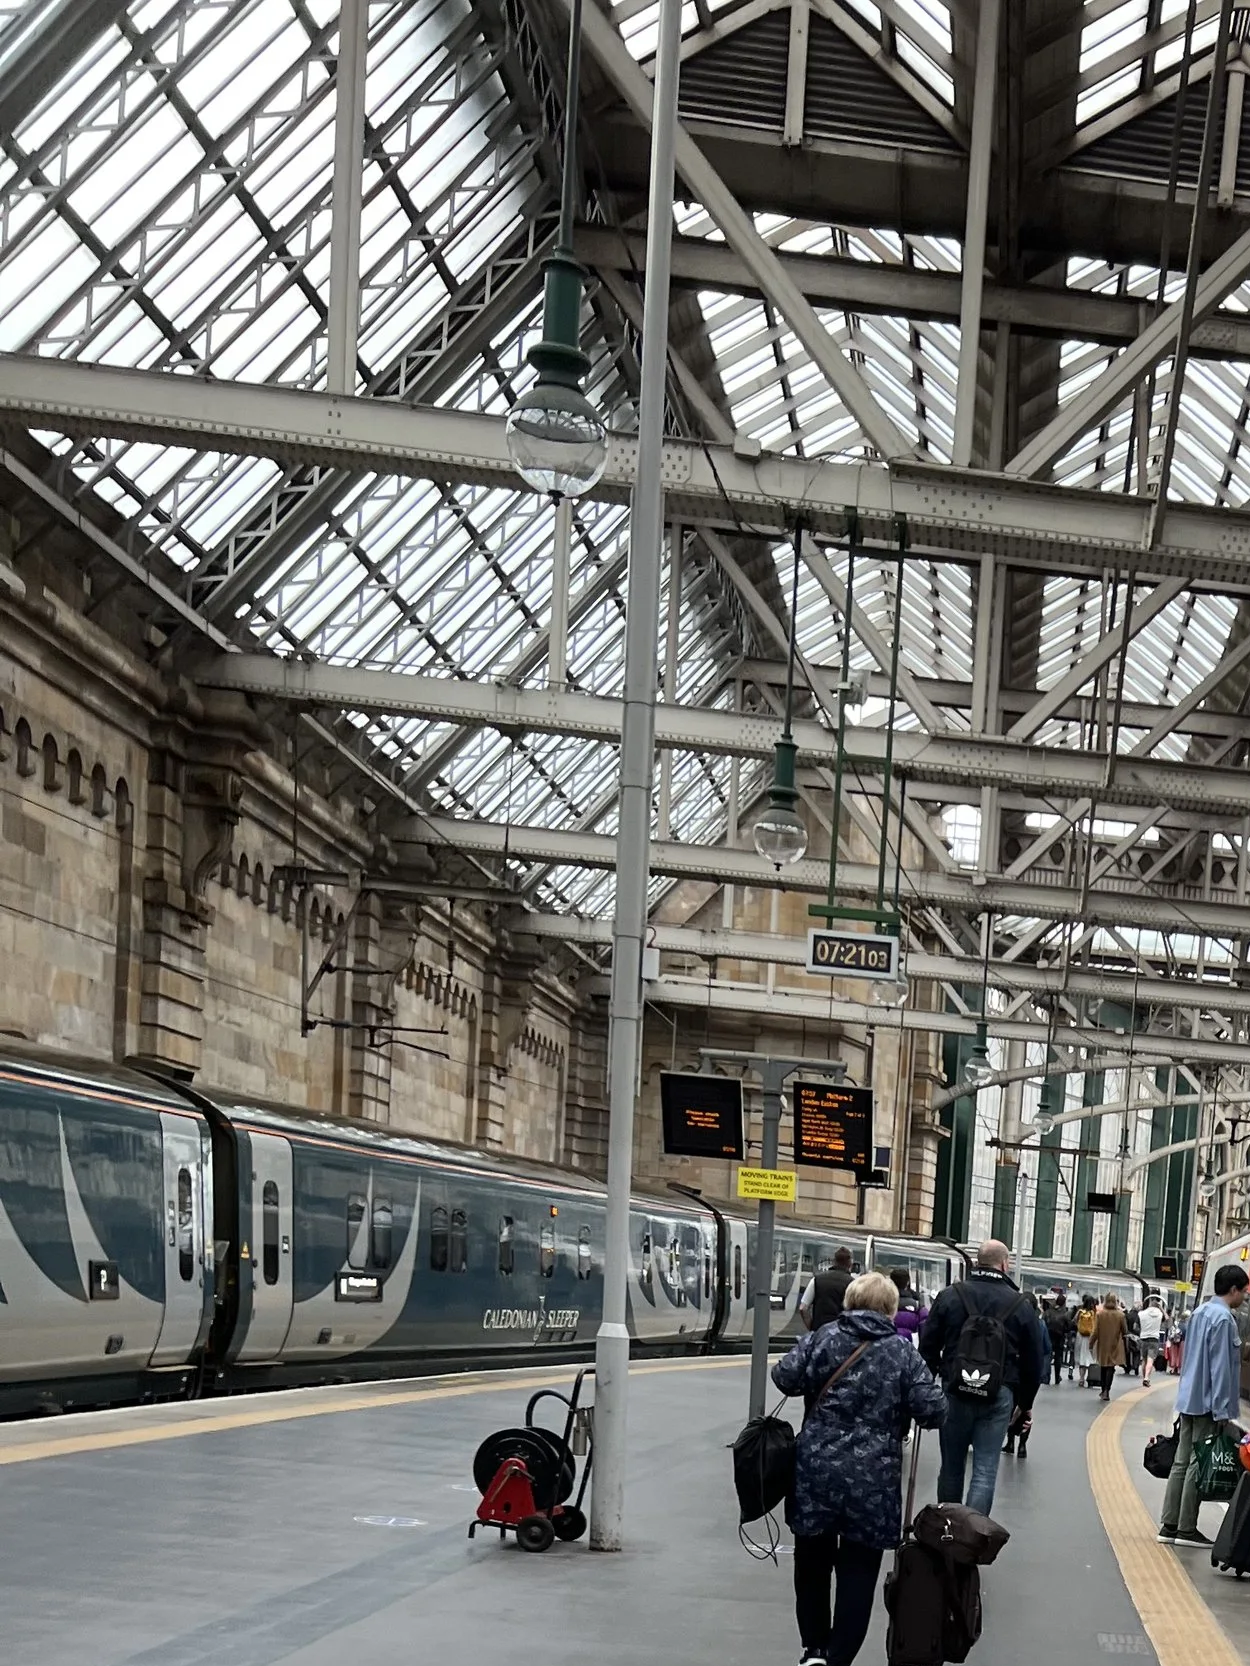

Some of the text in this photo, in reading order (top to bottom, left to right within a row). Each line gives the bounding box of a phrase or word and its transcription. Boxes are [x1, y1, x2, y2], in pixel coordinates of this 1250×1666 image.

[741, 1171, 793, 1182] MOVING TRAINS
[744, 1187, 773, 1195] PLATFORM
[483, 1308, 580, 1329] CALEDONIAN SLEEPER
[958, 1385, 988, 1397] adidas
